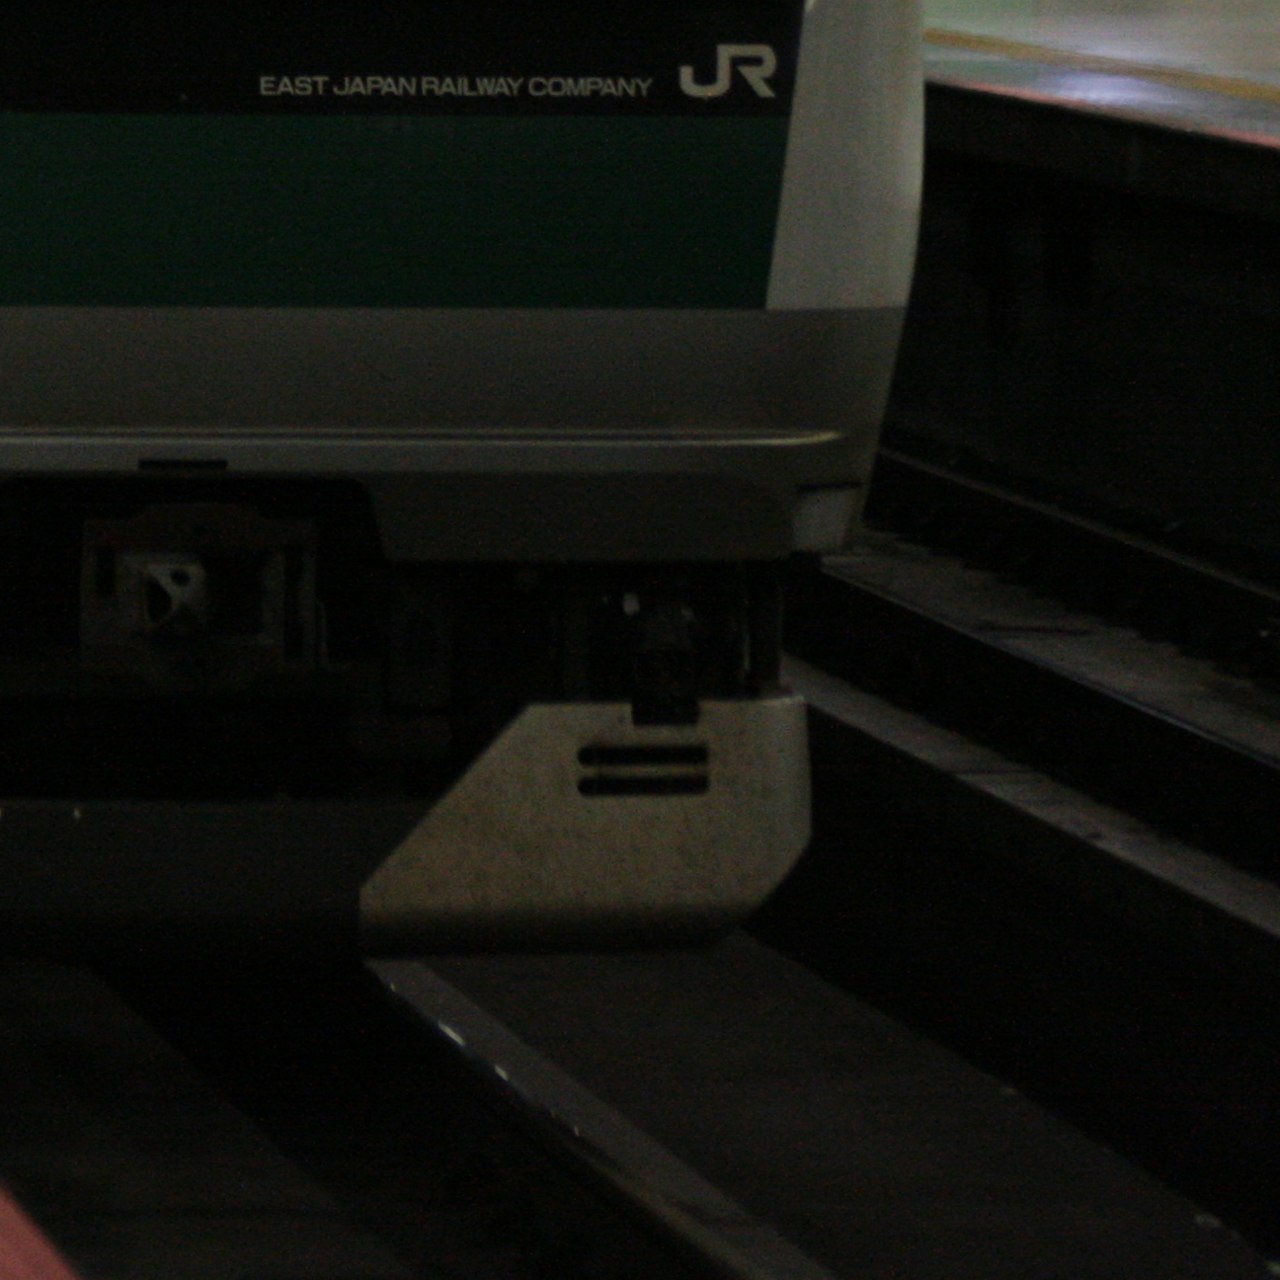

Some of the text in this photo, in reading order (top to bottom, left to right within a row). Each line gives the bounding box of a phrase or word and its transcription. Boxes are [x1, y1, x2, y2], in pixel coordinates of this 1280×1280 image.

[258, 75, 653, 98] EAST JAPAN RAILWAY COMPANY
[679, 43, 778, 99] JR
